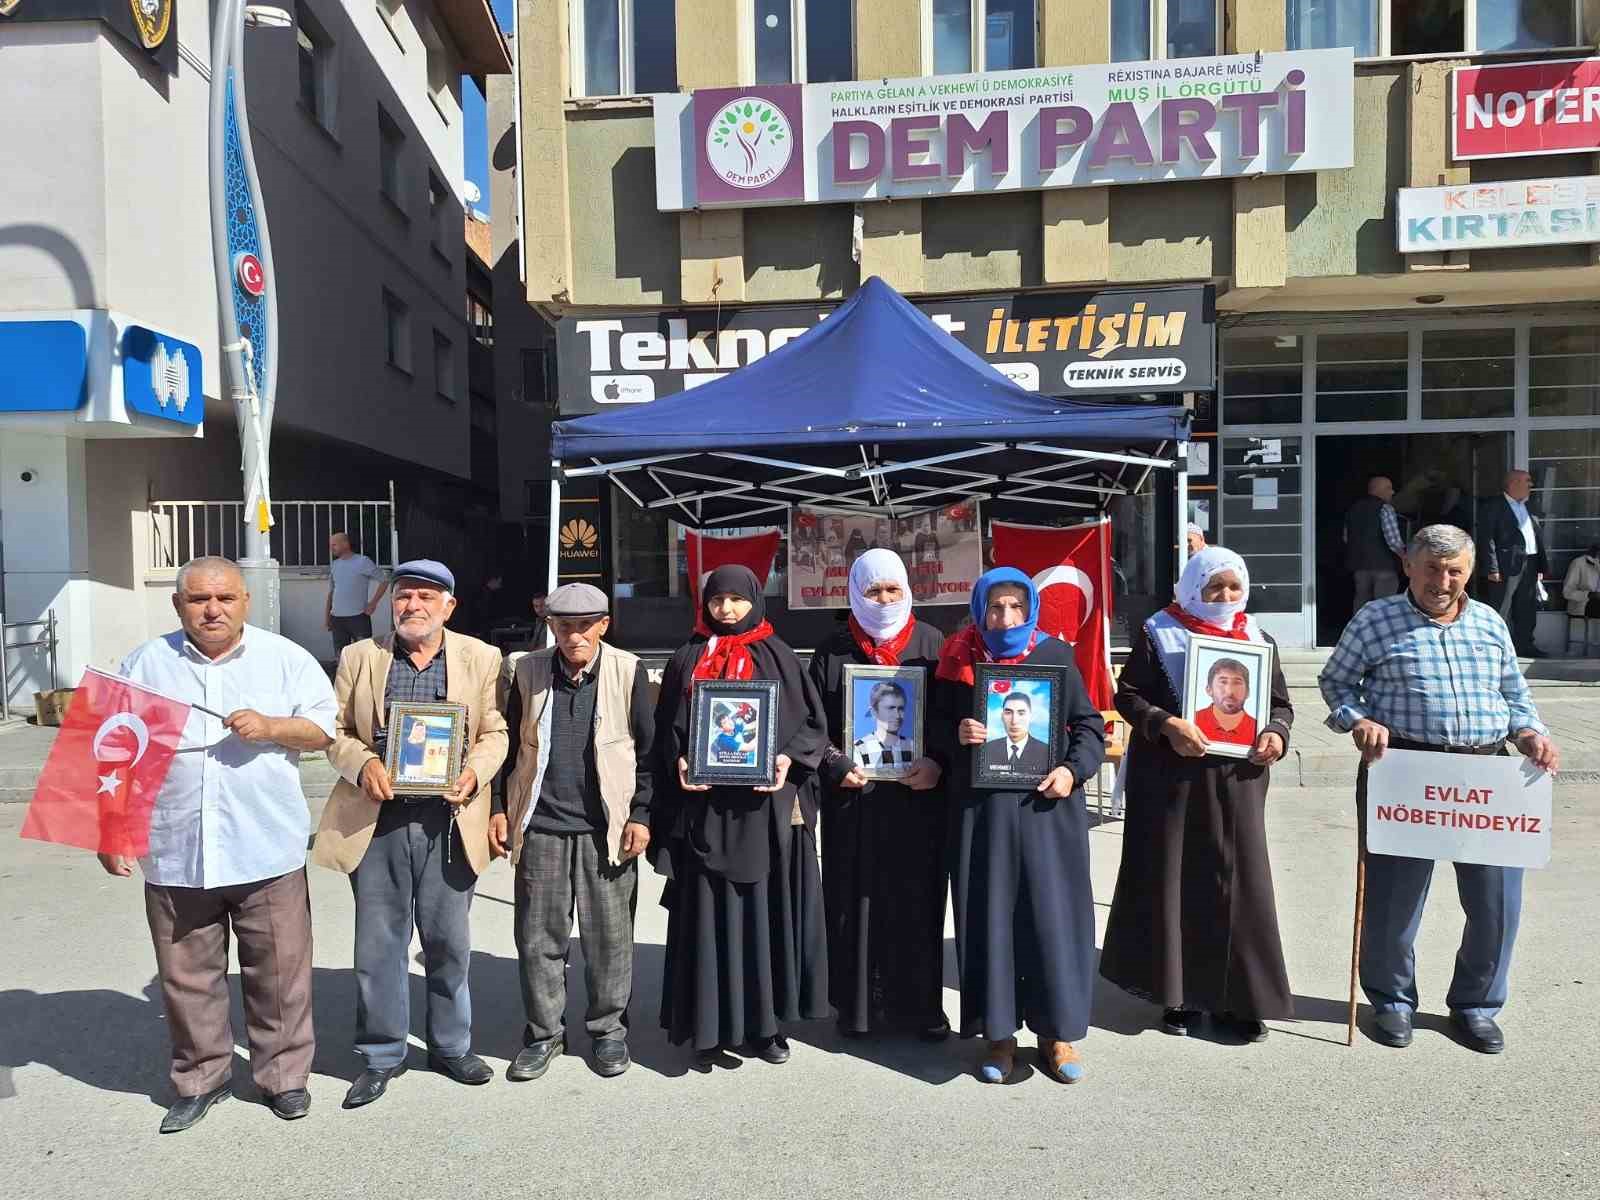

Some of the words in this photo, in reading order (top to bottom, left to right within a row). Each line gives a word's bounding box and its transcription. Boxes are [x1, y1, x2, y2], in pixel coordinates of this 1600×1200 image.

[1108, 86, 1150, 103] MUŞ
[1156, 82, 1173, 98] İL
[1179, 77, 1262, 97] ÖRGÜTÜ
[832, 105, 896, 118] HALKLARIN
[898, 101, 940, 115] EŞİTLİK
[943, 100, 957, 111] VE
[960, 93, 1025, 110] DEMOKRASİ
[1029, 89, 1073, 105] PARTİSİ
[832, 111, 1009, 184] DEM
[1039, 69, 1306, 171] PARTİ
[725, 170, 746, 183] DEM
[985, 302, 1187, 358] İLETİŞİM
[1068, 364, 1125, 381] TEKNİK
[1128, 362, 1182, 378] SERVİS
[560, 549, 598, 559] HUAWEI
[1424, 785, 1493, 805] EVLAT
[1376, 804, 1541, 834] NÖBETİNDEYİZ
